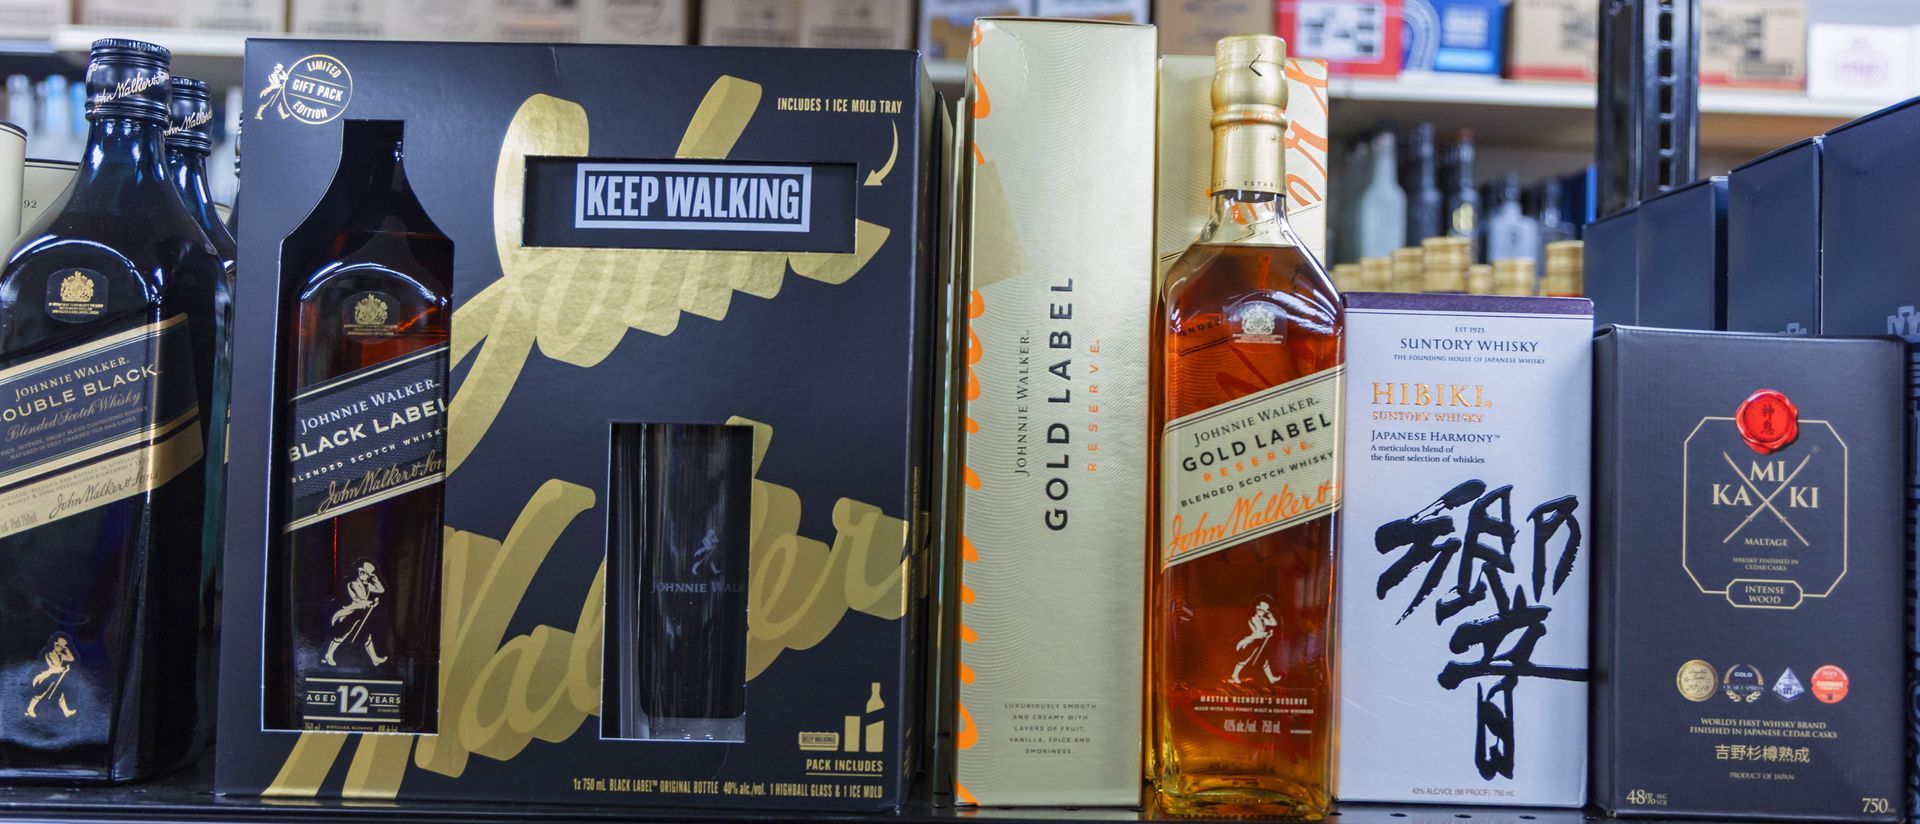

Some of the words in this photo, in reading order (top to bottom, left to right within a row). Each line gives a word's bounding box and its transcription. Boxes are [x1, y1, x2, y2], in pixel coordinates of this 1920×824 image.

[306, 60, 342, 79] LIMITED
[292, 78, 315, 95] GIFT
[317, 84, 344, 102] PACK
[292, 100, 328, 119] EDITION
[777, 97, 822, 111] INCLUDES
[825, 98, 829, 111] 1
[833, 98, 848, 112] ICE
[851, 99, 876, 113] MOLD
[880, 100, 902, 114] TRAY
[586, 175, 659, 217] KEEP
[664, 176, 800, 220] WALKING
[1047, 277, 1073, 404] LABEL
[1400, 337, 1473, 351] SUNTORY
[1477, 339, 1539, 353] WHISKY
[1017, 334, 1030, 400] WALKER
[1409, 354, 1446, 362] FOUNDING
[1518, 357, 1545, 365] WHISKY
[0, 389, 76, 422] OUBLE
[83, 363, 158, 397] BLACK
[15, 373, 73, 402] JOHNNIE
[74, 356, 127, 379] WALKER
[5, 413, 59, 442] Blended
[58, 399, 95, 423] Scotch
[95, 388, 142, 412] Whisky
[301, 400, 369, 435] JOHNNIE
[370, 379, 435, 407] WALKER
[1087, 342, 1100, 473] RESERVE
[1372, 411, 1431, 422] SUNTORY
[1435, 412, 1484, 423] WHISKY
[288, 423, 367, 462] BLACK
[372, 398, 448, 434] LABEL
[1194, 416, 1256, 448] JOHNNIE
[1257, 397, 1316, 423] WALKER
[1371, 430, 1426, 442] JAPANESE
[1014, 404, 1031, 477] JOHNNIE
[1182, 440, 1247, 473] GOLD
[1254, 413, 1332, 449] LABEL
[1378, 444, 1420, 453] meticulous
[1422, 445, 1444, 453] blend
[1445, 445, 1455, 453] of
[291, 461, 343, 484] BLENDED
[350, 444, 396, 464] SCOTCH
[403, 428, 447, 447] WHISK
[1203, 440, 1309, 484] RESERVE
[1384, 454, 1405, 462] finest
[1407, 454, 1440, 463] selection
[1442, 455, 1450, 463] of
[1452, 455, 1485, 464] whiskies
[317, 480, 361, 516] John
[360, 463, 411, 496] Walker
[1044, 422, 1070, 531] GOLD
[1181, 484, 1235, 508] BLENDED
[1238, 467, 1286, 488] SCOTCH
[1289, 450, 1335, 472] WHISKY
[1712, 483, 1752, 506] KA
[1750, 460, 1786, 482] MI
[1789, 486, 1819, 509] KI
[49, 493, 84, 519] John
[83, 478, 125, 504] Walker
[1163, 511, 1227, 562] John
[1226, 483, 1314, 536] Walker
[1744, 538, 1788, 547] MALTAGE
[650, 581, 708, 594] JOHNNIE
[1745, 585, 1785, 594] INTENSE
[1749, 595, 1781, 604] WOOD
[306, 694, 337, 703] AGED
[336, 685, 369, 714] 12
[368, 695, 401, 704] YEARS
[1690, 726, 1730, 735] FINISHED
[1732, 727, 1741, 735] IN
[1744, 728, 1781, 737] JAPANESE
[1782, 729, 1811, 738] CEDAR
[1812, 730, 1838, 739] CASKS
[1739, 718, 1760, 727] FIRST
[1762, 719, 1796, 729] WHISKY
[1797, 721, 1827, 730] BRAND
[806, 758, 831, 771] PACK
[835, 759, 884, 772] INCLUDES
[1729, 771, 1761, 780] PRODUCT
[1763, 772, 1772, 780] OF
[1774, 773, 1795, 781] JAPAN
[582, 778, 595, 791] 750
[609, 778, 631, 792] BLACK
[660, 780, 691, 793] ORIGINAL
[693, 781, 719, 794] BOTTLE
[723, 781, 738, 795] 40%
[775, 783, 808, 797] HIGHBALL
[811, 784, 833, 797] GLASS
[835, 784, 841, 797] &
[850, 785, 861, 798] ICE
[863, 785, 883, 799] MOLD
[1862, 797, 1888, 814] 750
